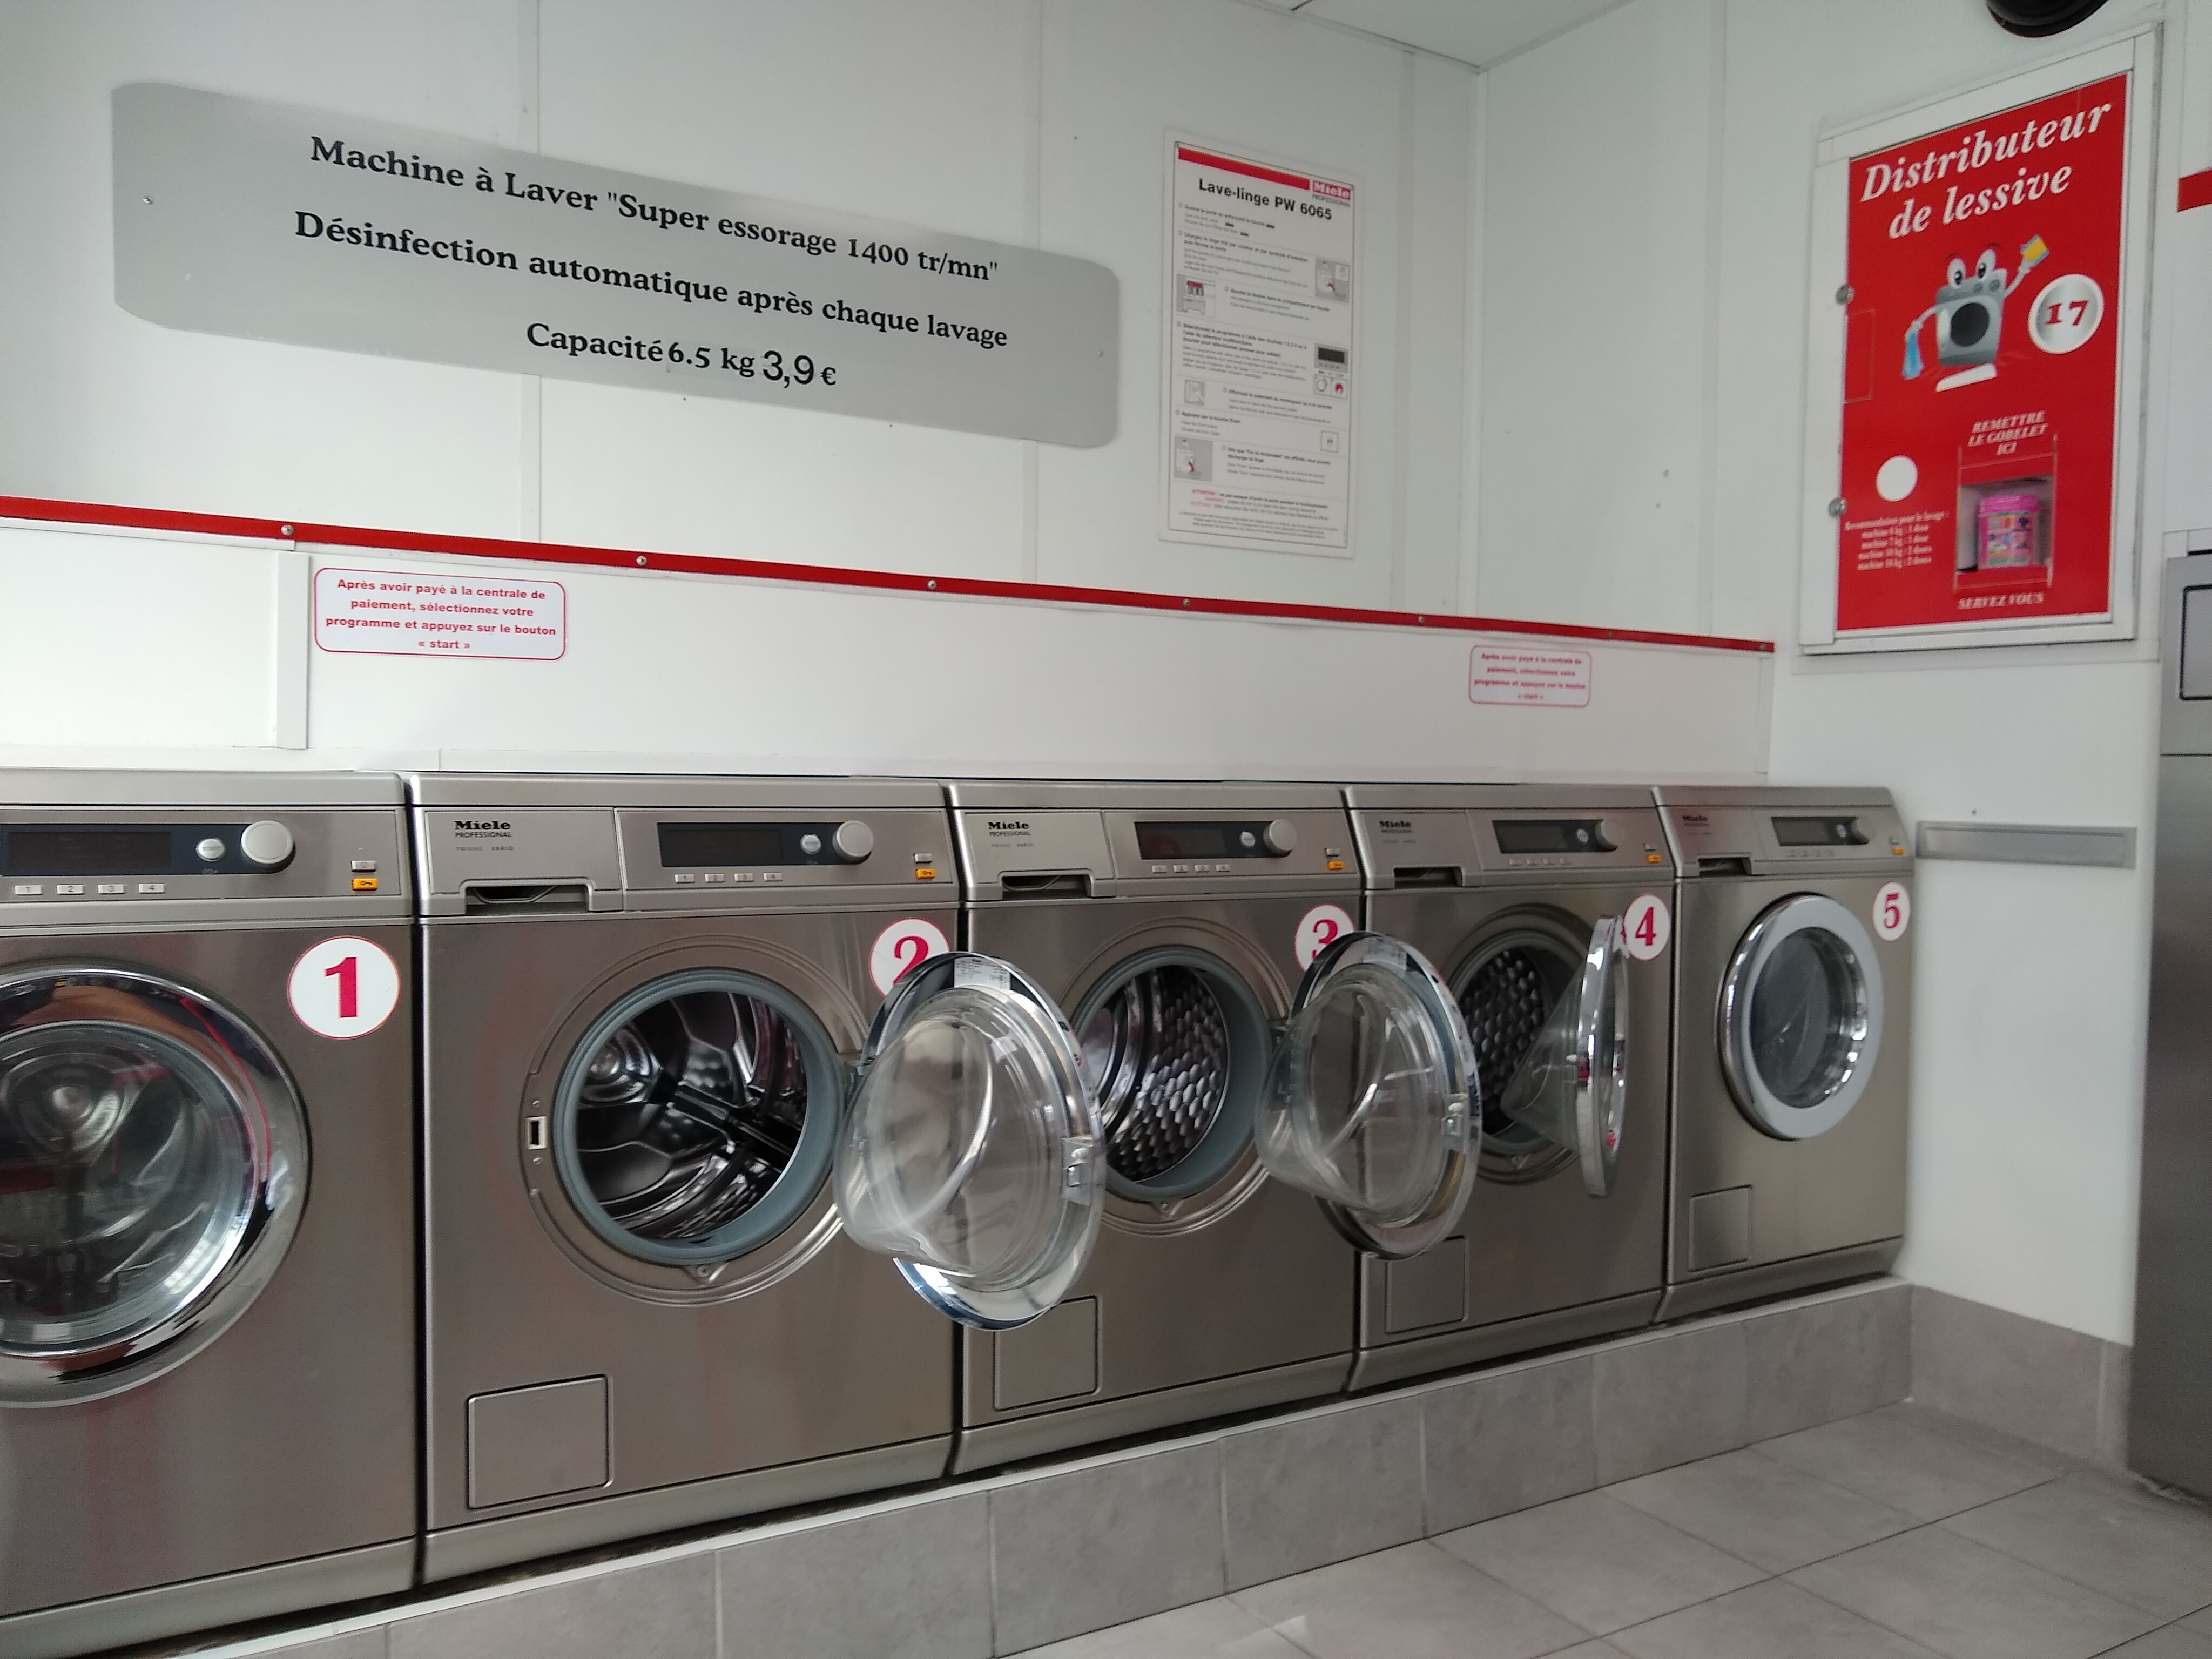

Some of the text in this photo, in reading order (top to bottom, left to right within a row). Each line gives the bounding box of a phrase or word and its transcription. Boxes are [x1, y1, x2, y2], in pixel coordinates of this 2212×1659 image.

[1860, 103, 2112, 203] Distributeur
[311, 136, 997, 280] Machine à Laver "Super essorage 1400 tr/mn"
[1199, 178, 1332, 220] Lave-linge PW 6065
[1313, 181, 1350, 199] Miele
[1889, 166, 2072, 240] de lessive
[295, 211, 1007, 350] Désinfection automatique après chaque lavage
[2046, 300, 2089, 326] 17
[527, 323, 837, 388] Capacité 6.5 kg 3,9 €
[338, 579, 545, 600] Après avoir payé à la centrale de
[350, 598, 534, 617] paiement, sélectionnez votre
[326, 617, 556, 636] programme et appuyez sur le bouton
[429, 639, 460, 649] start
[454, 821, 511, 830] Miele
[988, 821, 1029, 830] Miele
[1635, 907, 1656, 946] 4
[1884, 893, 1900, 929] 5
[893, 936, 929, 986] 2
[324, 956, 357, 1018] 1
